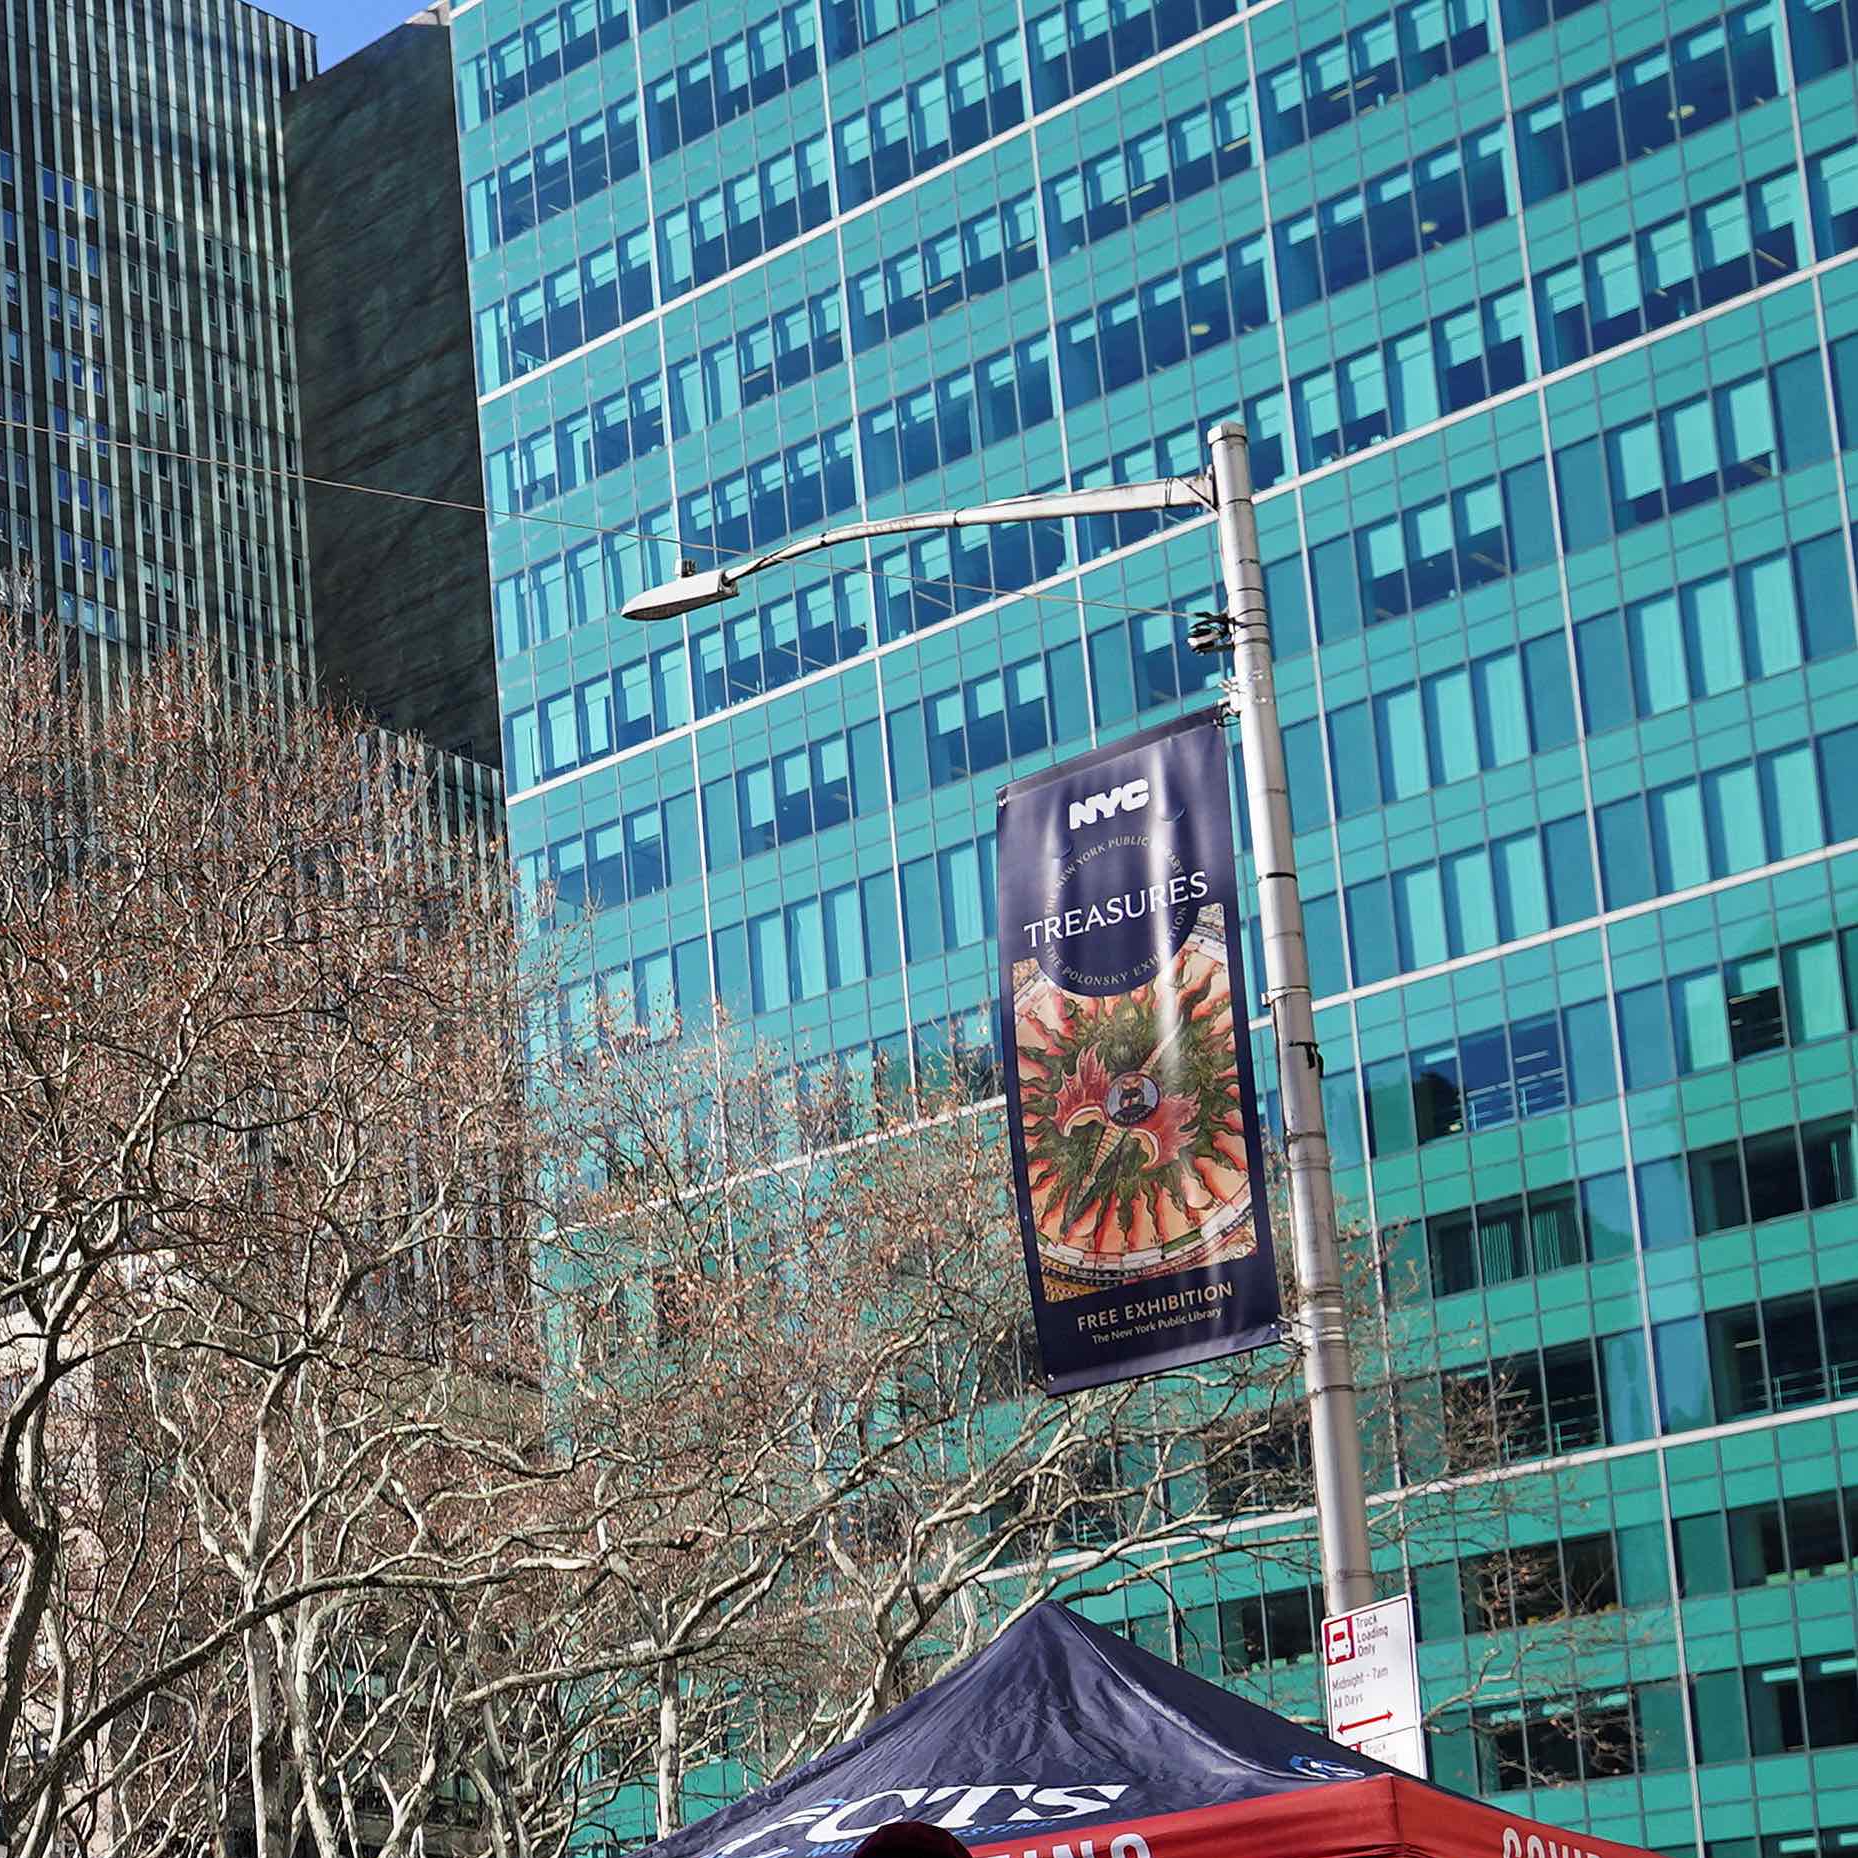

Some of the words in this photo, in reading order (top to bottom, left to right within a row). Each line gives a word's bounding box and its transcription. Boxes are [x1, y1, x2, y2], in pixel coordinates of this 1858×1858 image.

[1069, 778, 1150, 830] NYC
[1055, 864, 1076, 889] NEW
[1076, 844, 1106, 865] YORK
[1107, 835, 1149, 849] PUBLIC
[1023, 871, 1209, 948] TREASURES
[1062, 965, 1129, 987] POLONSKY
[1077, 1308, 1119, 1332] FREE
[1125, 1281, 1234, 1321] EXHIBITION
[1092, 1333, 1110, 1345] The
[1111, 1329, 1134, 1341] New
[1134, 1322, 1156, 1335] York
[1157, 1314, 1187, 1329] Public
[1188, 1307, 1222, 1323] Library
[1356, 1614, 1378, 1629] Truck
[1356, 1626, 1389, 1644] Loading
[1358, 1644, 1376, 1658] Only
[1332, 1672, 1364, 1691] Midnight
[1372, 1667, 1389, 1680] 7am
[1344, 1694, 1364, 1708] Days
